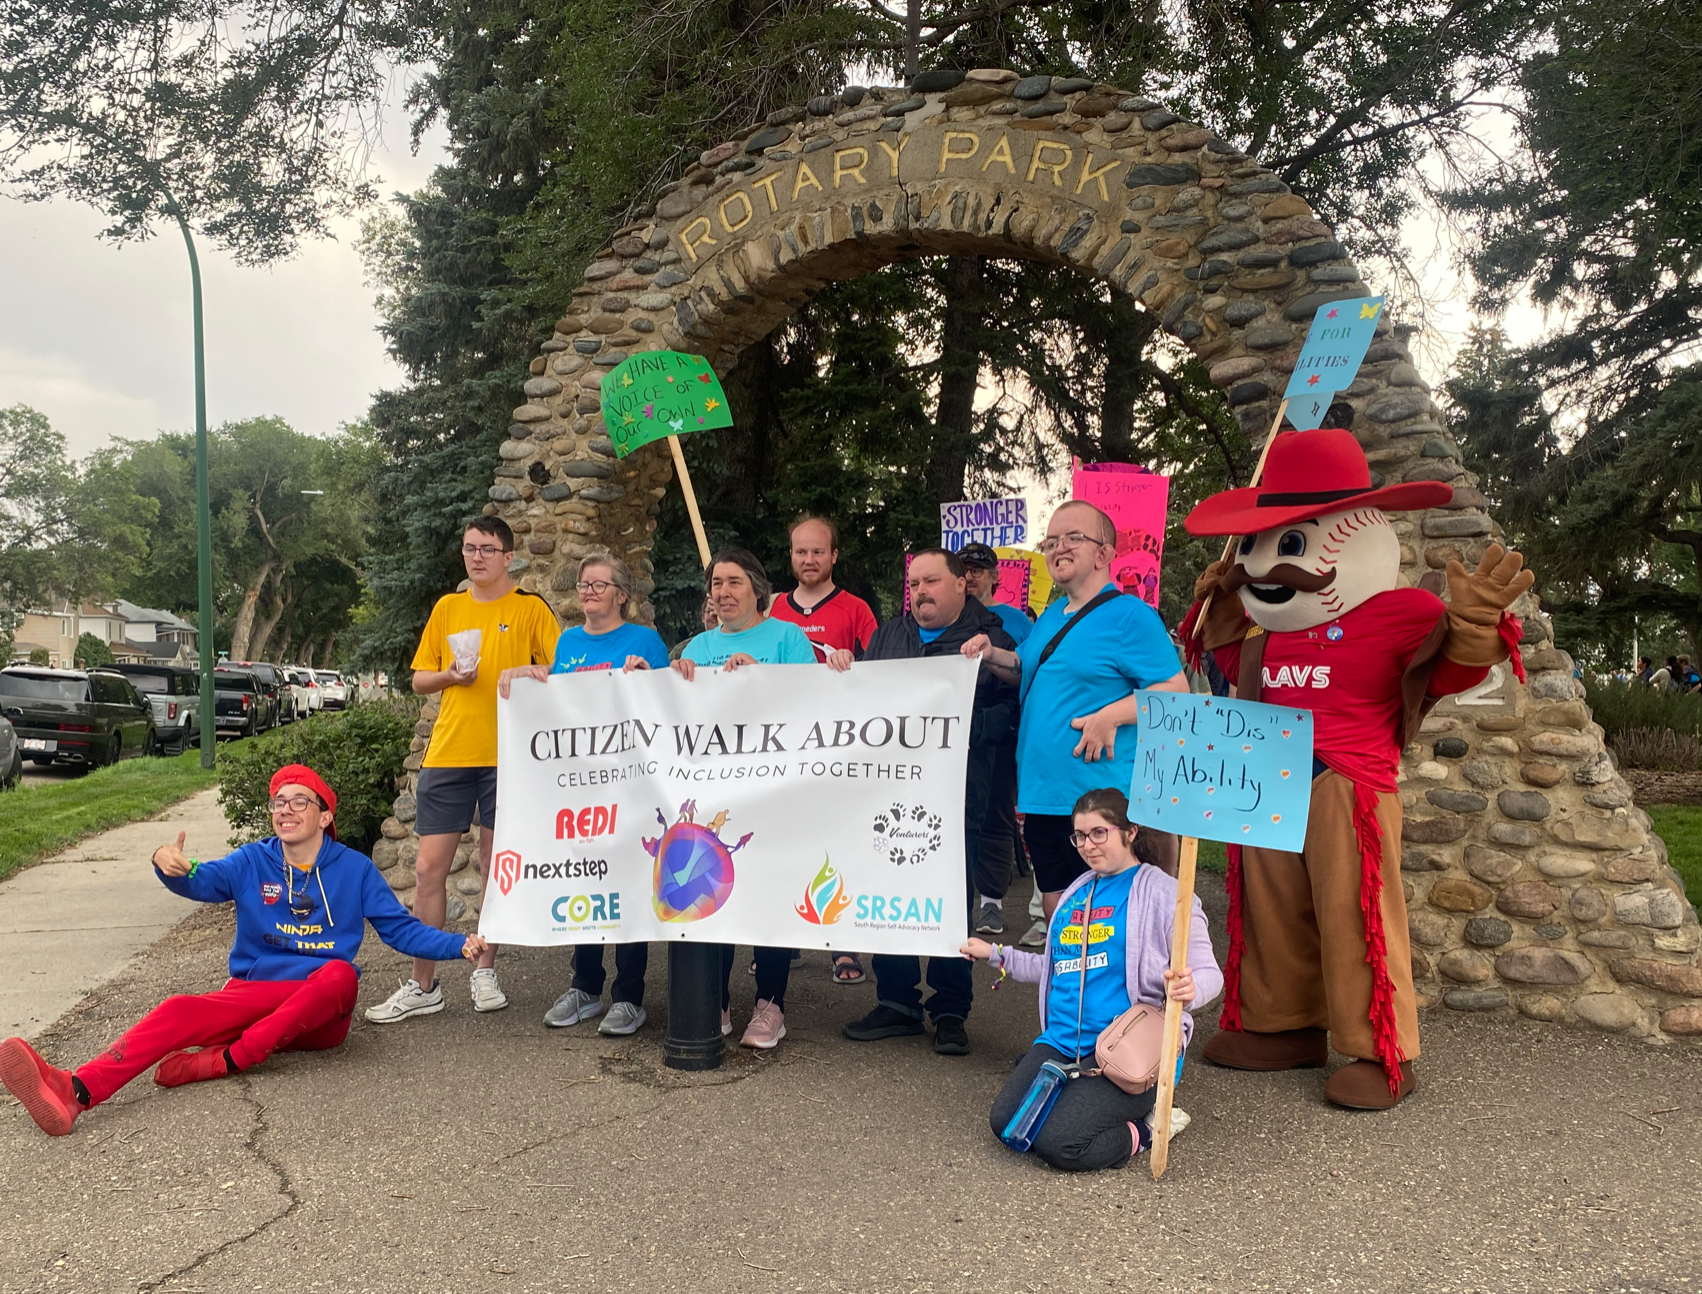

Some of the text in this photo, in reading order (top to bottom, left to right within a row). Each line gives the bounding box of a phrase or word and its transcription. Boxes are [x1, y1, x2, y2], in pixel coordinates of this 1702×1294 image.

[678, 130, 1122, 263] ROTARY PARK
[1320, 326, 1351, 341] FOR
[628, 355, 670, 382] HAVE
[675, 355, 688, 368] A
[610, 379, 695, 418] VOICE OF
[656, 400, 696, 424] OWN
[945, 498, 1028, 529] STRONGER
[1147, 695, 1203, 736] Don't
[529, 715, 960, 762] CITIZEN WALK ABOUT
[557, 760, 922, 788] CELEBRATING INCLUSION TOGETHER
[1143, 748, 1261, 812] My Ability
[555, 803, 618, 840] REDI
[523, 856, 608, 881] nextstep
[551, 892, 621, 923] CORE
[855, 894, 943, 923] SRSAN
[275, 921, 323, 937] NINJA
[870, 922, 886, 931] Region
[294, 939, 336, 949] THAT
